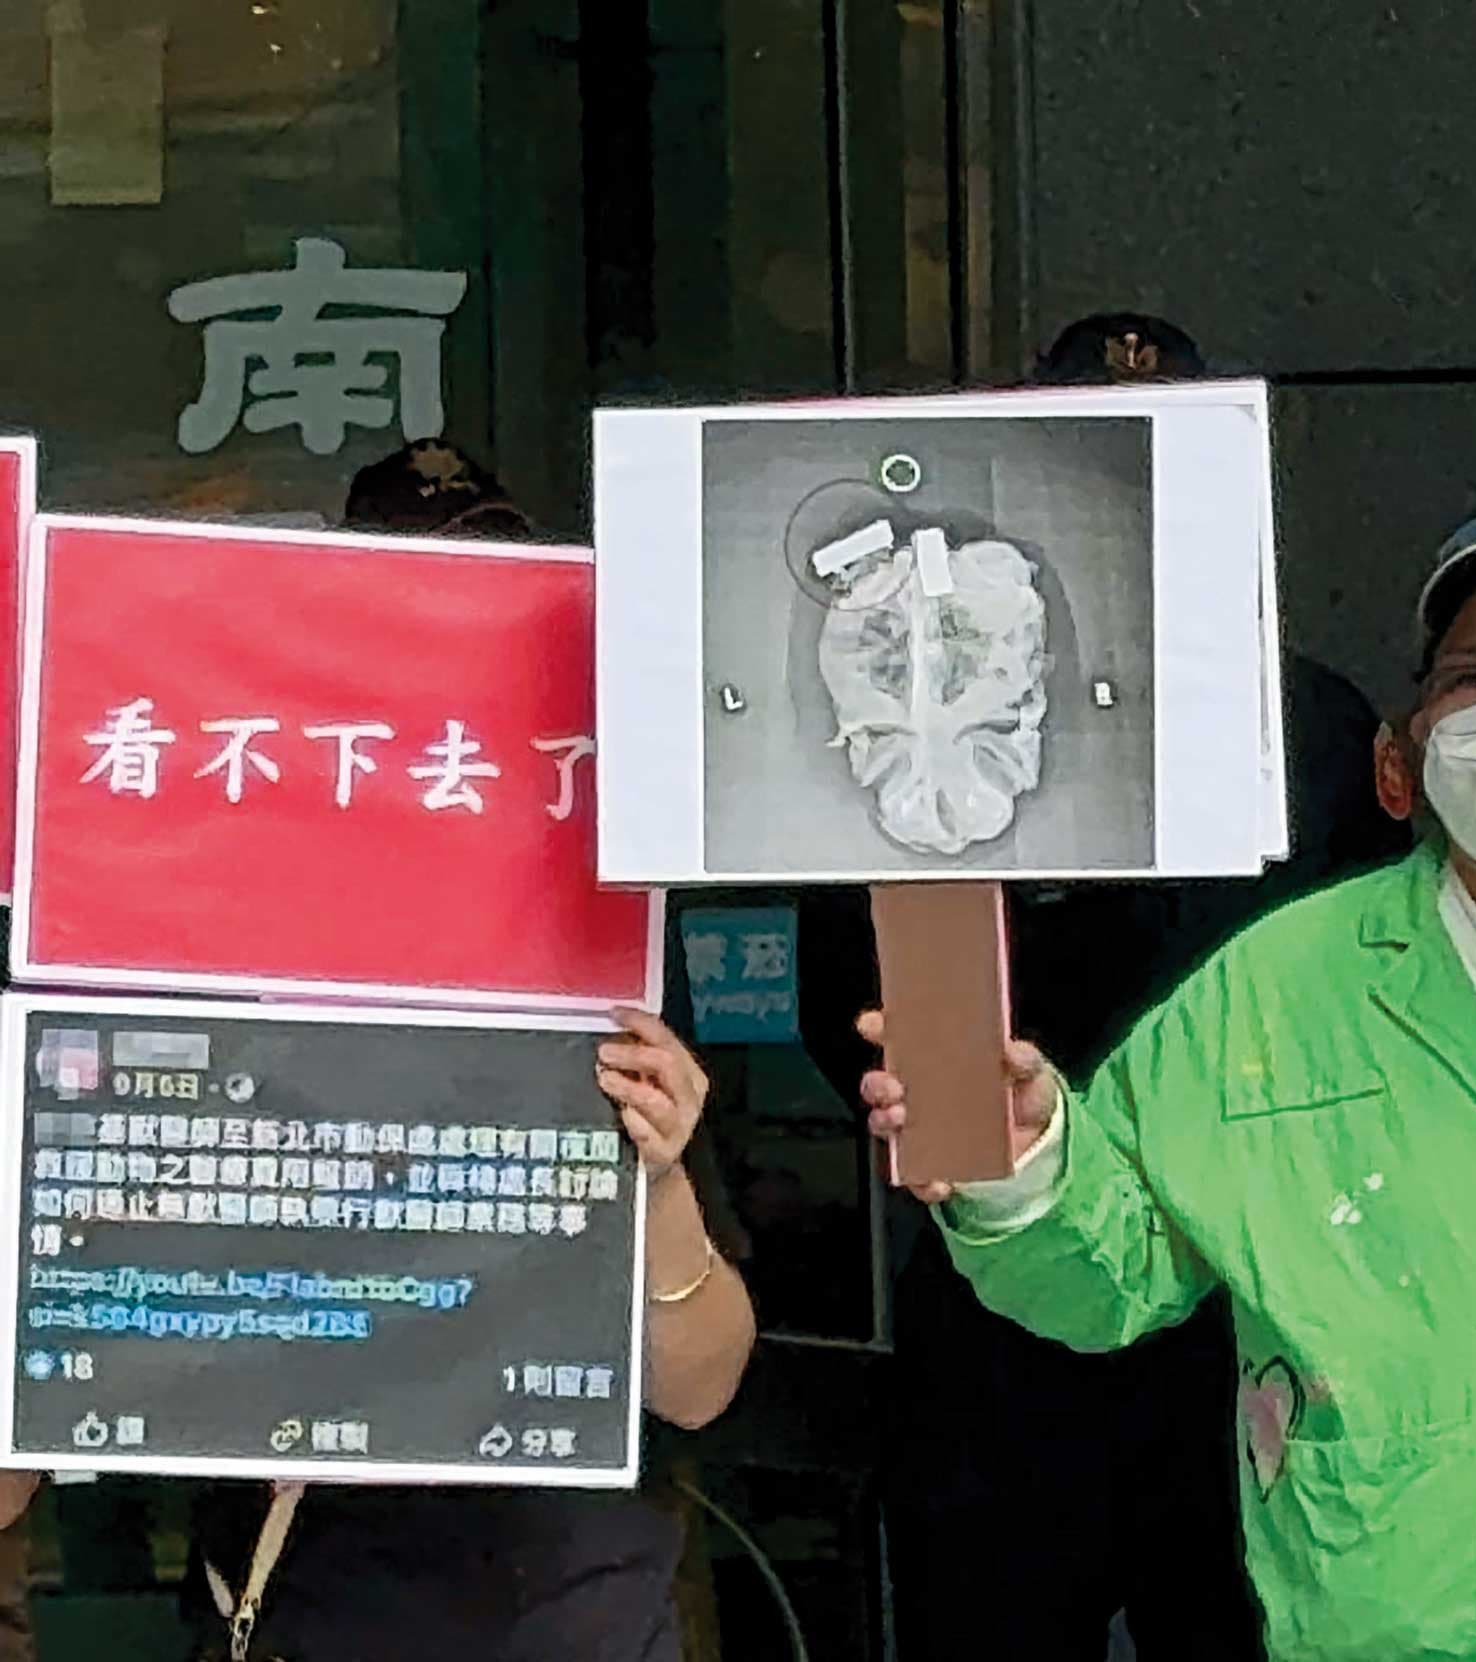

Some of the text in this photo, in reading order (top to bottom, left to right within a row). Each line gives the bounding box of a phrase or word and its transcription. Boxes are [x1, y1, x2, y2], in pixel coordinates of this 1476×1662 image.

[168, 237, 468, 455] 南
[79, 697, 595, 821] 看不下去了
[61, 1351, 94, 1381] 18
